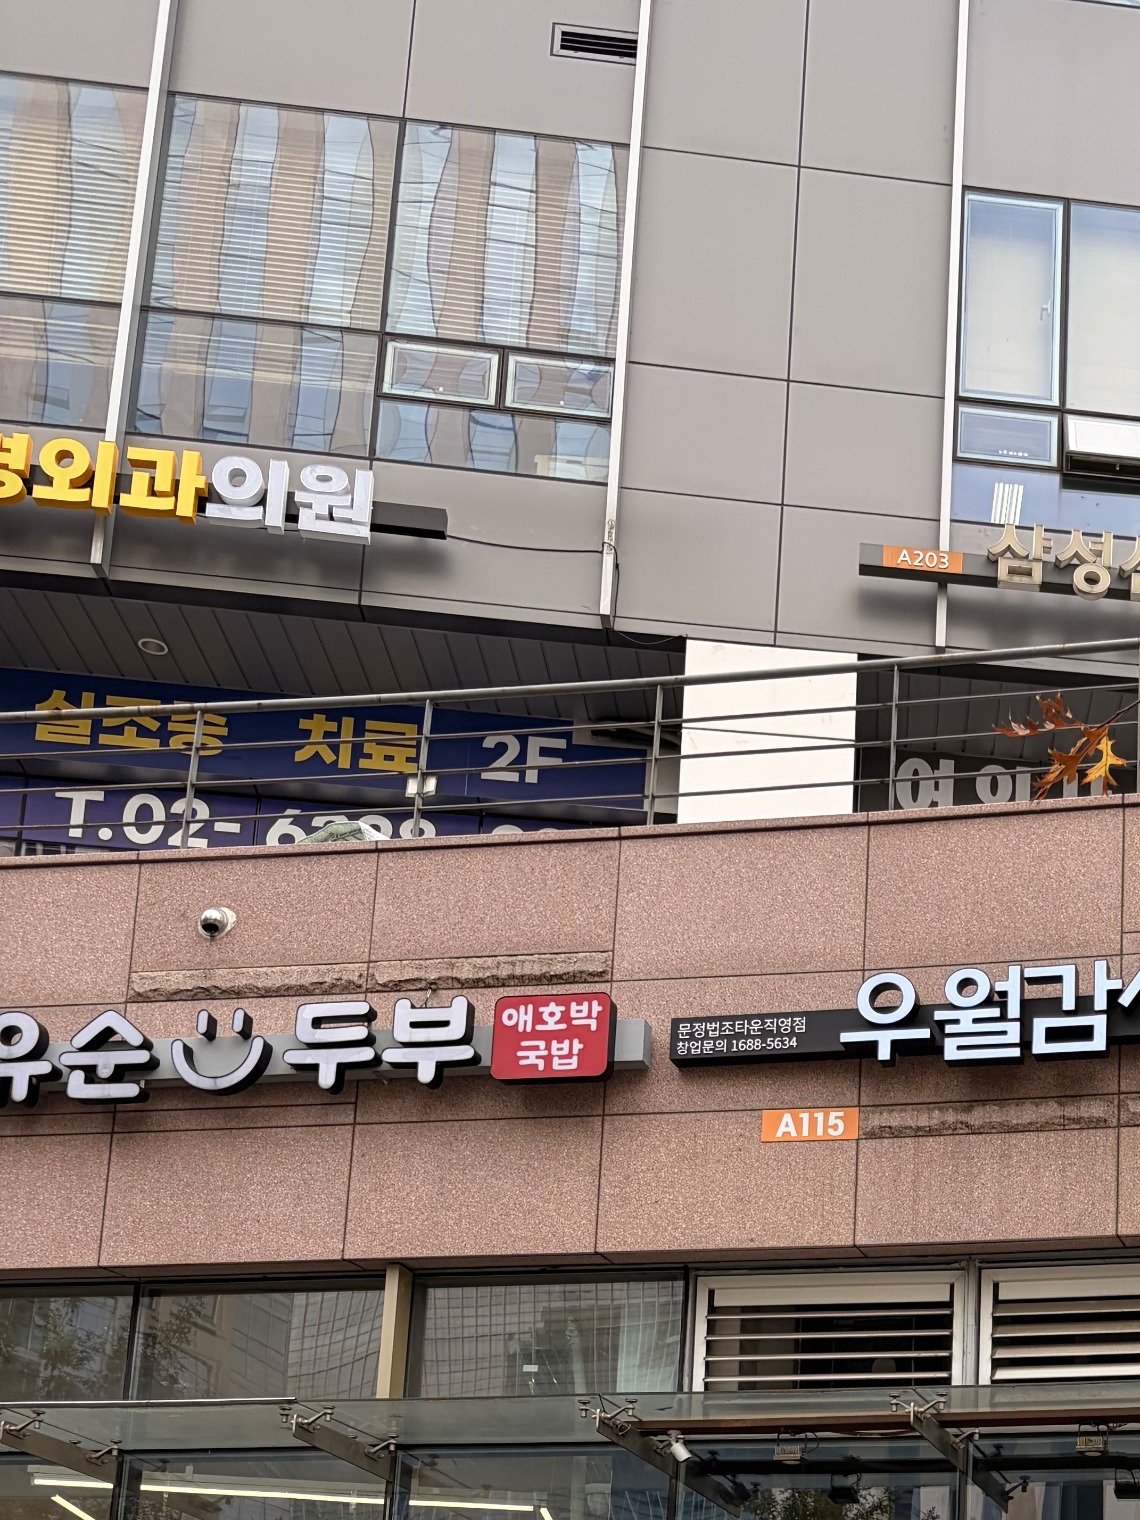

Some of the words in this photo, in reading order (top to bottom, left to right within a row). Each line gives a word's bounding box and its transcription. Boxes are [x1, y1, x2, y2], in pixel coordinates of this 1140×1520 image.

[897, 550, 950, 570] A203
[294, 713, 419, 773] 치료
[481, 735, 568, 784] 2F
[501, 1000, 603, 1032] 애호박
[677, 1016, 806, 1039] 문정법조타운직영점
[282, 996, 476, 1090] 두부
[516, 1038, 584, 1071] 국밥
[676, 1039, 727, 1055] 창업문의
[731, 1037, 798, 1052] 1688-5634
[776, 1113, 844, 1137] A115
